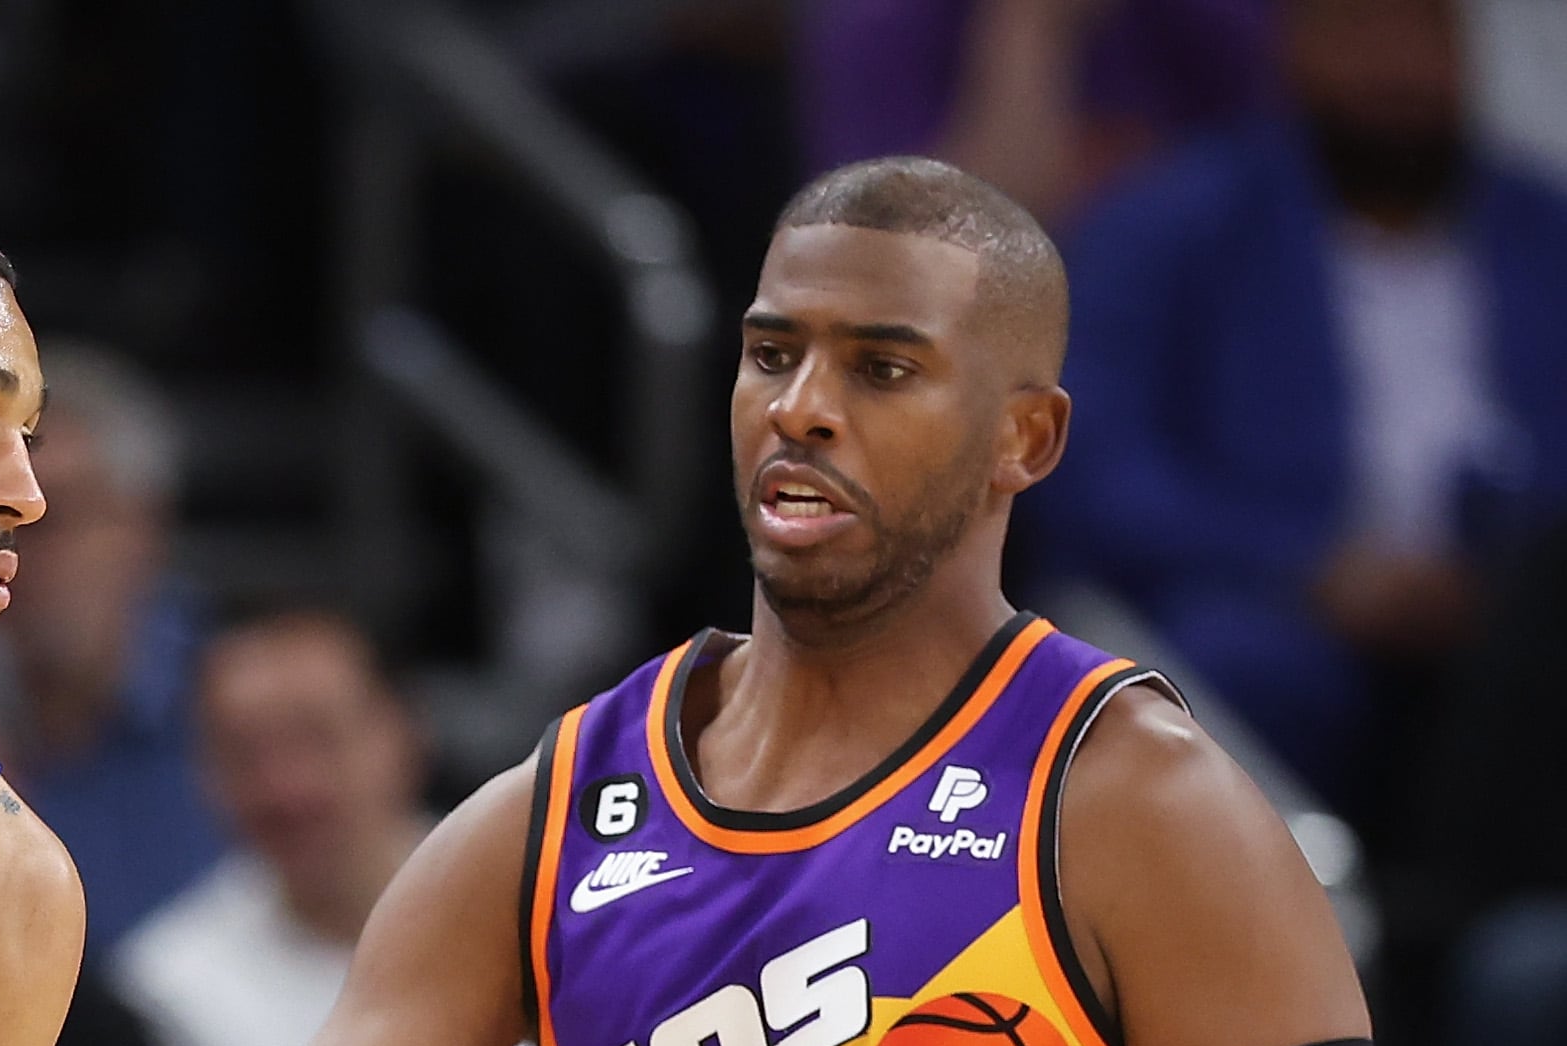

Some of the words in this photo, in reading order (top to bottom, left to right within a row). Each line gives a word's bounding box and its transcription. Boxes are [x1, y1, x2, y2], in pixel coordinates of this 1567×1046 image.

[595, 782, 640, 836] 6
[888, 825, 1007, 860] PayPal
[589, 851, 669, 887] NIKE
